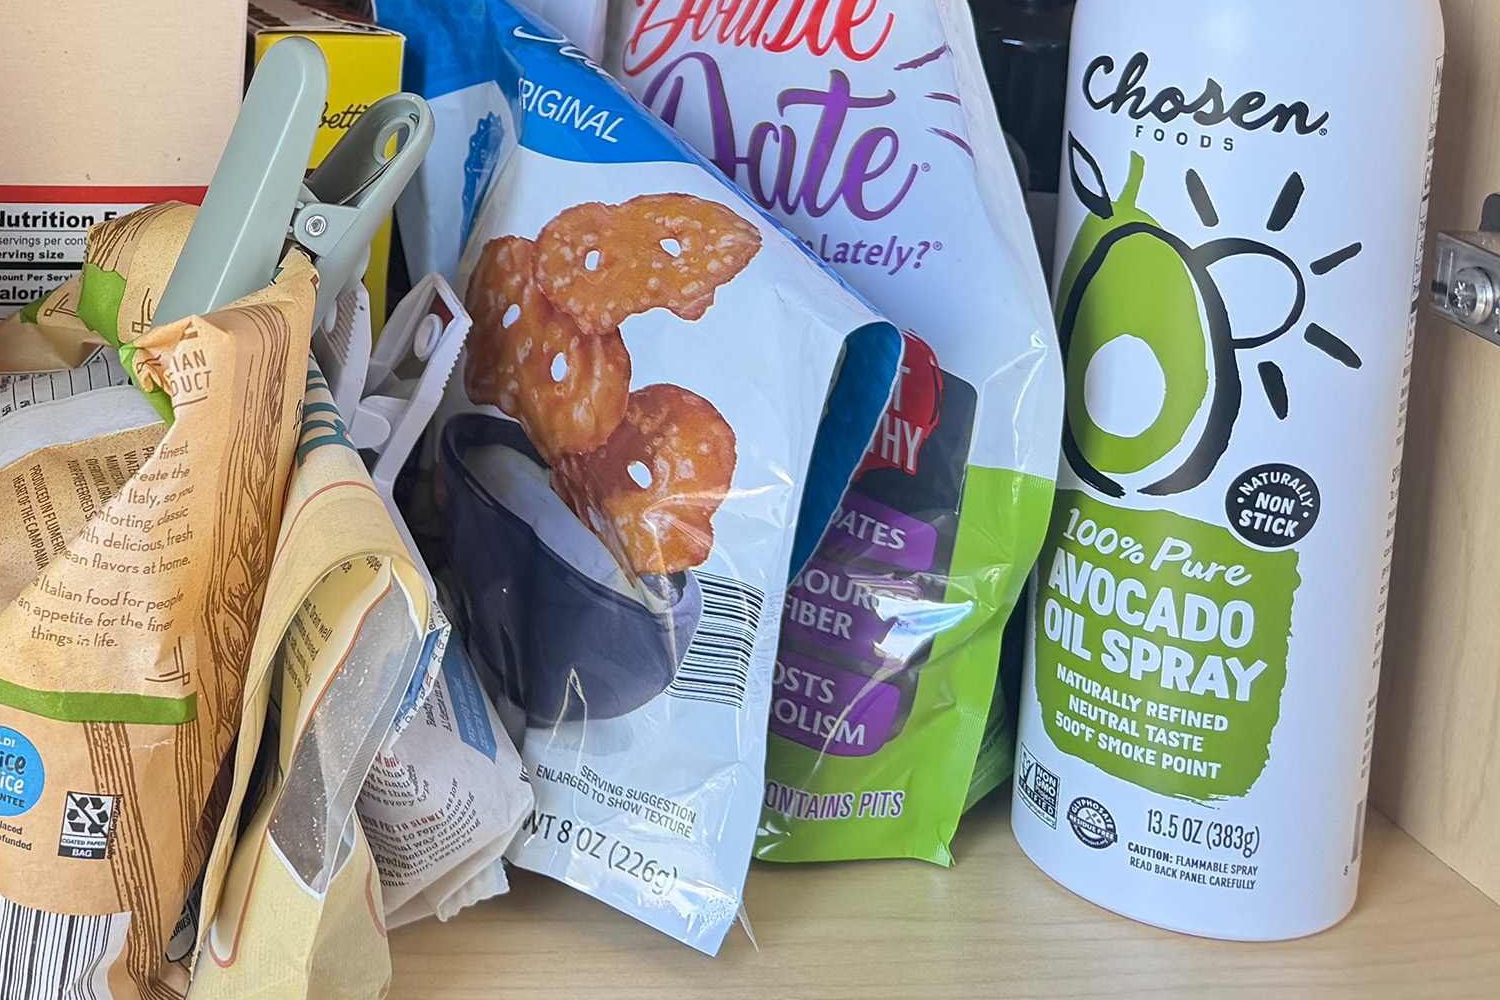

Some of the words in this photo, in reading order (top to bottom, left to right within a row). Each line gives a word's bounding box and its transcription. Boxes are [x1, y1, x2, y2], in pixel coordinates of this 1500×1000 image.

[1134, 124, 1236, 152] FOODS
[38, 249, 65, 260] size
[43, 237, 63, 250] per
[26, 272, 48, 282] Per
[1238, 471, 1315, 509] NATURALLY
[1254, 491, 1296, 517] NON
[166, 523, 193, 547] fresh
[1238, 509, 1300, 539] STICK
[92, 552, 140, 575] flavors
[159, 555, 192, 573] home.
[1063, 507, 1146, 566] 100%
[1150, 536, 1253, 588] Pure
[40, 574, 83, 603] Italian
[86, 588, 121, 606] food
[122, 590, 145, 608] for
[1048, 546, 1255, 649] AVOCADO
[33, 603, 94, 627] appetite
[96, 611, 119, 628] for
[120, 611, 145, 630] the
[31, 623, 74, 647] things
[93, 632, 119, 648] life.
[1043, 598, 1092, 662] OIL
[1100, 628, 1268, 702] SPRAY
[1055, 663, 1143, 714] NATURALLY
[1145, 702, 1229, 732] REFINED
[1068, 694, 1140, 738] NEUTRAL
[1144, 724, 1204, 753] TASTE
[1055, 710, 1095, 743] 500°F
[1097, 728, 1156, 767] SMOKE
[1160, 753, 1222, 780] POINT
[536, 763, 591, 796] ENLARGED
[590, 789, 606, 805] TO
[606, 792, 644, 817] SHOW
[643, 807, 694, 839] TEXTURE
[580, 765, 624, 797] SERVING
[625, 786, 698, 824] SUGGESTION
[764, 778, 855, 820] ONTAINS
[858, 789, 905, 820] PITS
[1146, 808, 1178, 841] 13.5
[1182, 818, 1203, 845] OZ
[1205, 822, 1261, 858] (383g)
[71, 847, 94, 859] BAG
[556, 818, 574, 845] 8
[575, 826, 608, 859] OZ
[607, 840, 679, 895] (226g)
[1127, 841, 1174, 865] CAUTION:
[1175, 854, 1229, 877] FLAMMABLE
[1229, 863, 1259, 878] SPRAY
[1129, 855, 1153, 874] READ
[1154, 862, 1178, 880] BACK
[1179, 868, 1208, 886] PANEL
[1208, 873, 1256, 890] CAREFULLY
